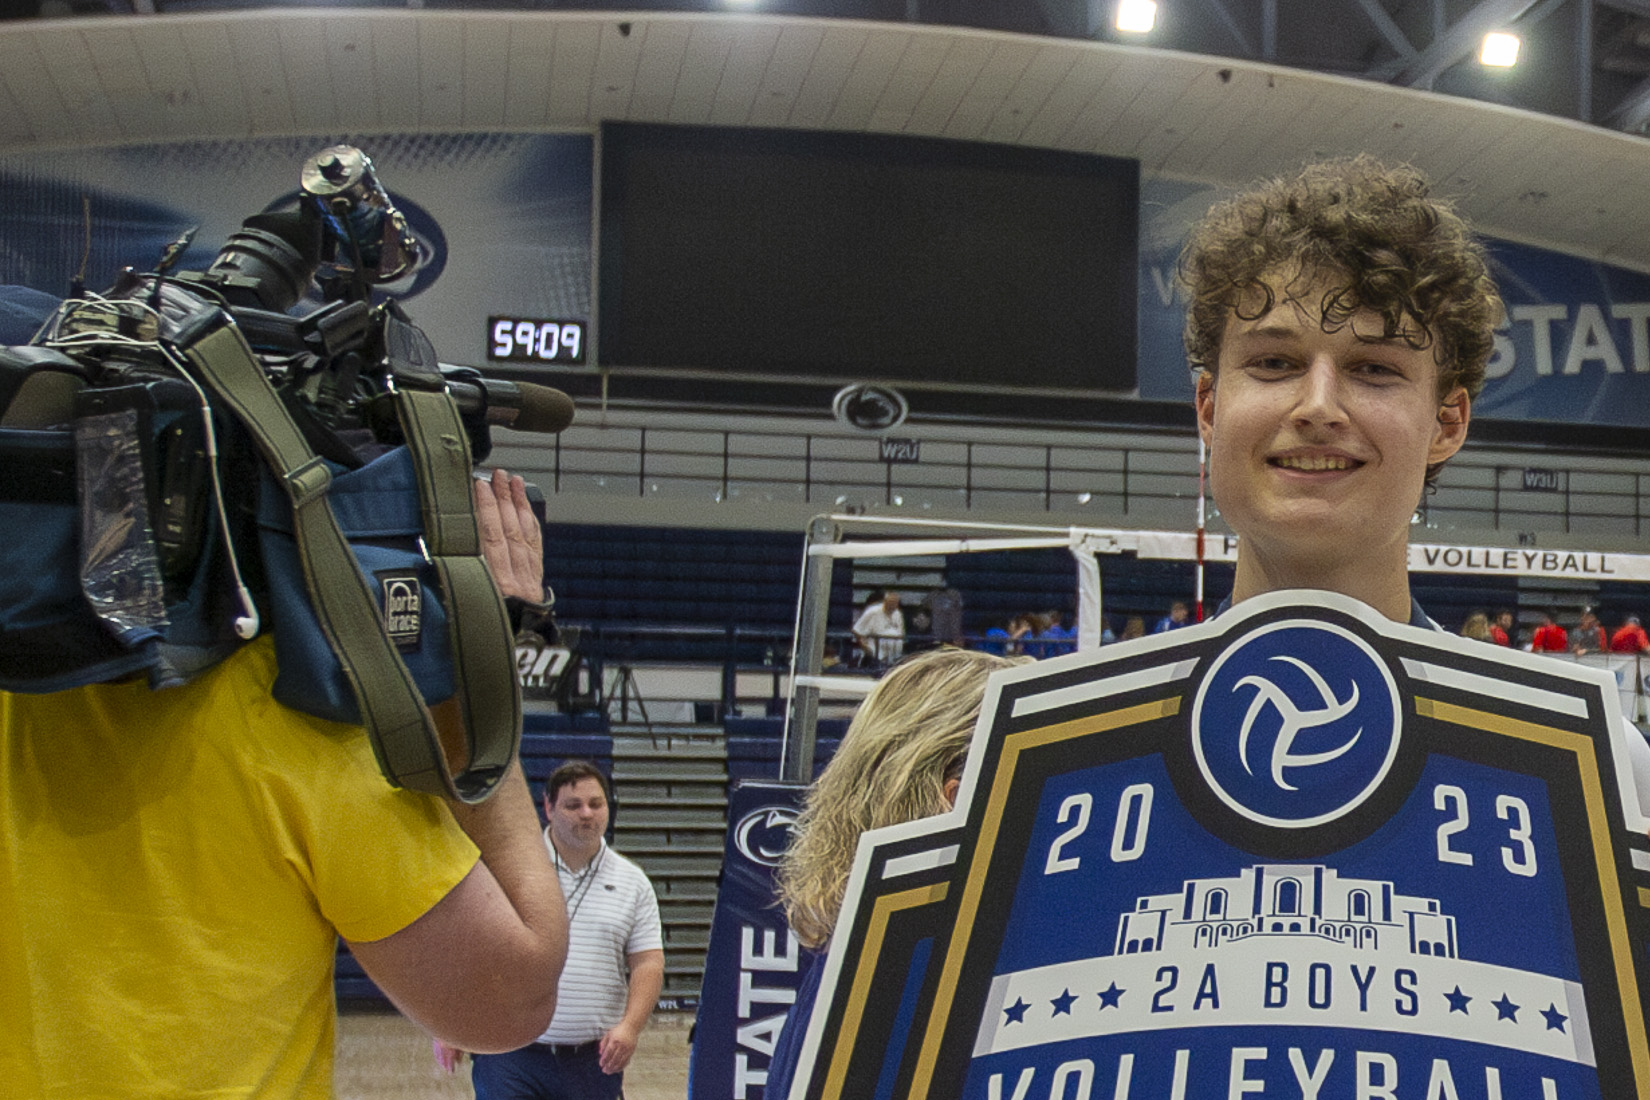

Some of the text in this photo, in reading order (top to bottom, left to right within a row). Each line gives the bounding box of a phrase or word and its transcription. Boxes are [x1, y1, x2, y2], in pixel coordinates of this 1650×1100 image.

[494, 320, 581, 360] 59:09
[1423, 546, 1615, 576] VOLLEYBALL
[1044, 783, 1539, 878] 20 23
[1149, 961, 1420, 1017] 2A BOYS
